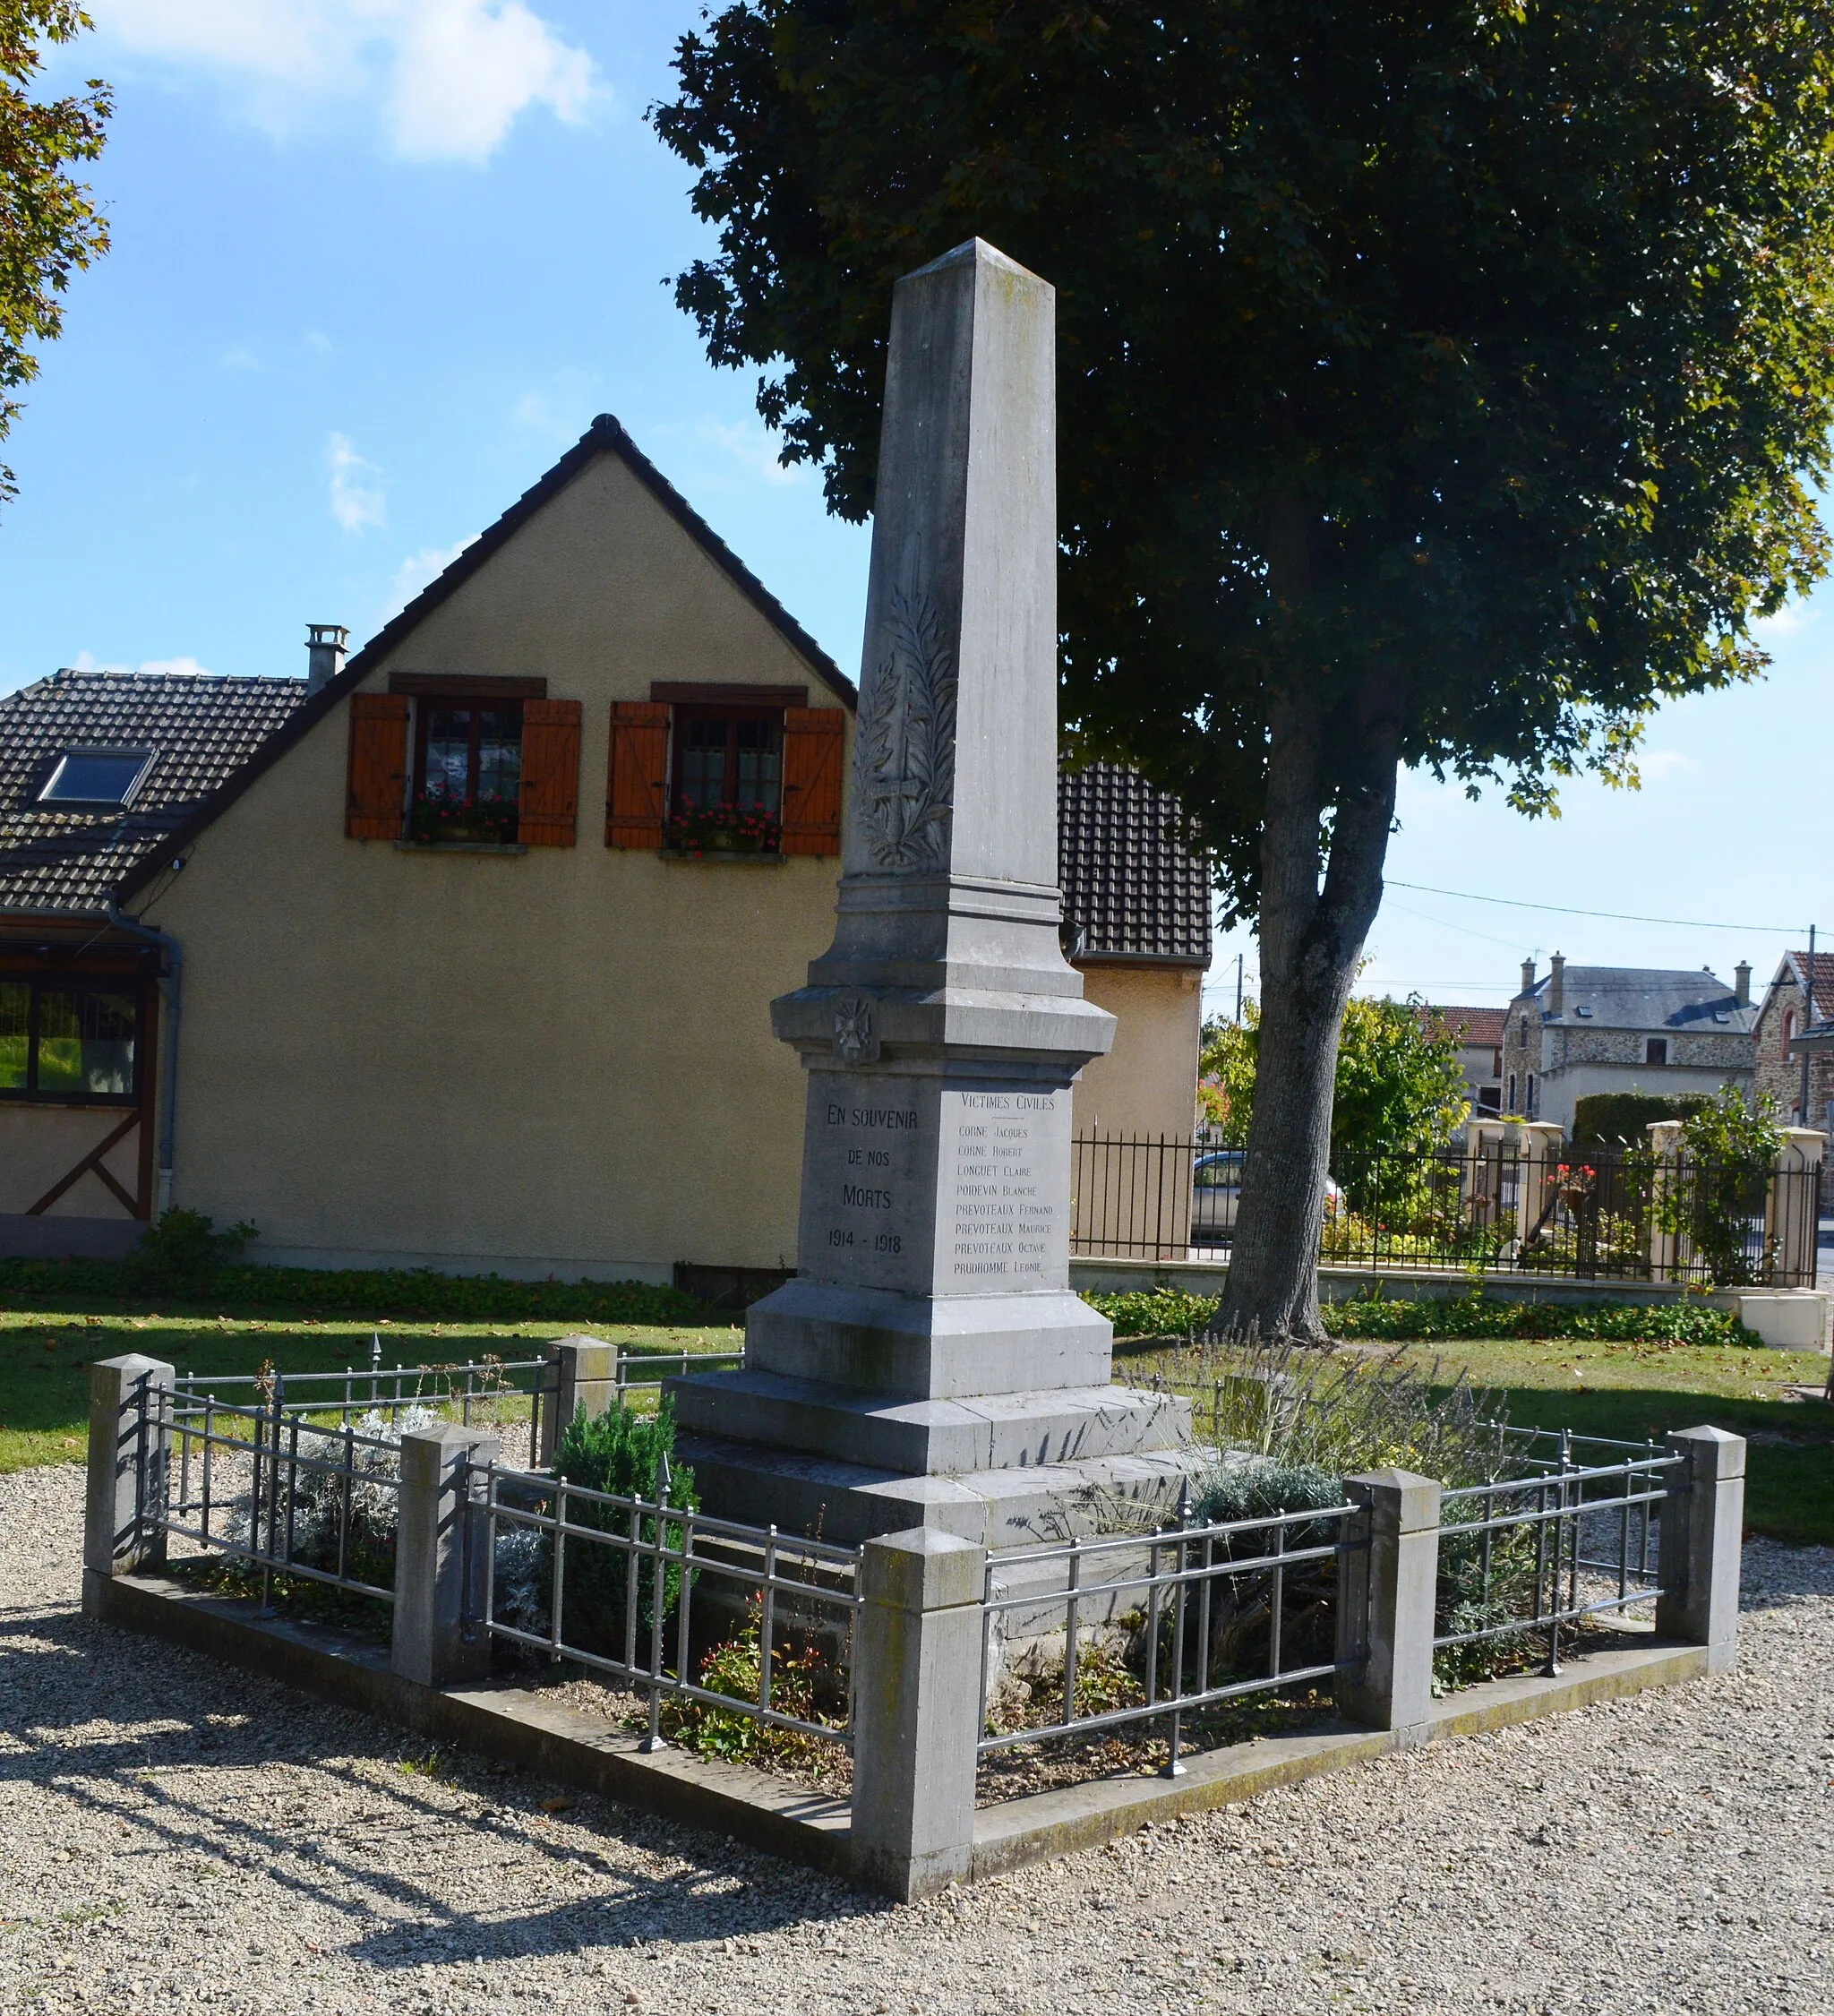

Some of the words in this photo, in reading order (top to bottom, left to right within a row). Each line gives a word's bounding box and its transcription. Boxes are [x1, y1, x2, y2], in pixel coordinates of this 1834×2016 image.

[961, 1093, 1010, 1110] VICTIMES
[1016, 1095, 1055, 1111] CIVILES
[827, 1104, 846, 1125] EN
[852, 1109, 917, 1128] SOUVENIR
[848, 1150, 862, 1165] DE
[868, 1151, 889, 1166] NOS
[843, 1185, 891, 1209] MORTS
[956, 1185, 998, 1197] POIDEVIN
[829, 1230, 854, 1248] 1914
[875, 1234, 901, 1254] 1918
[954, 1261, 1008, 1274] PRUDHOMME
